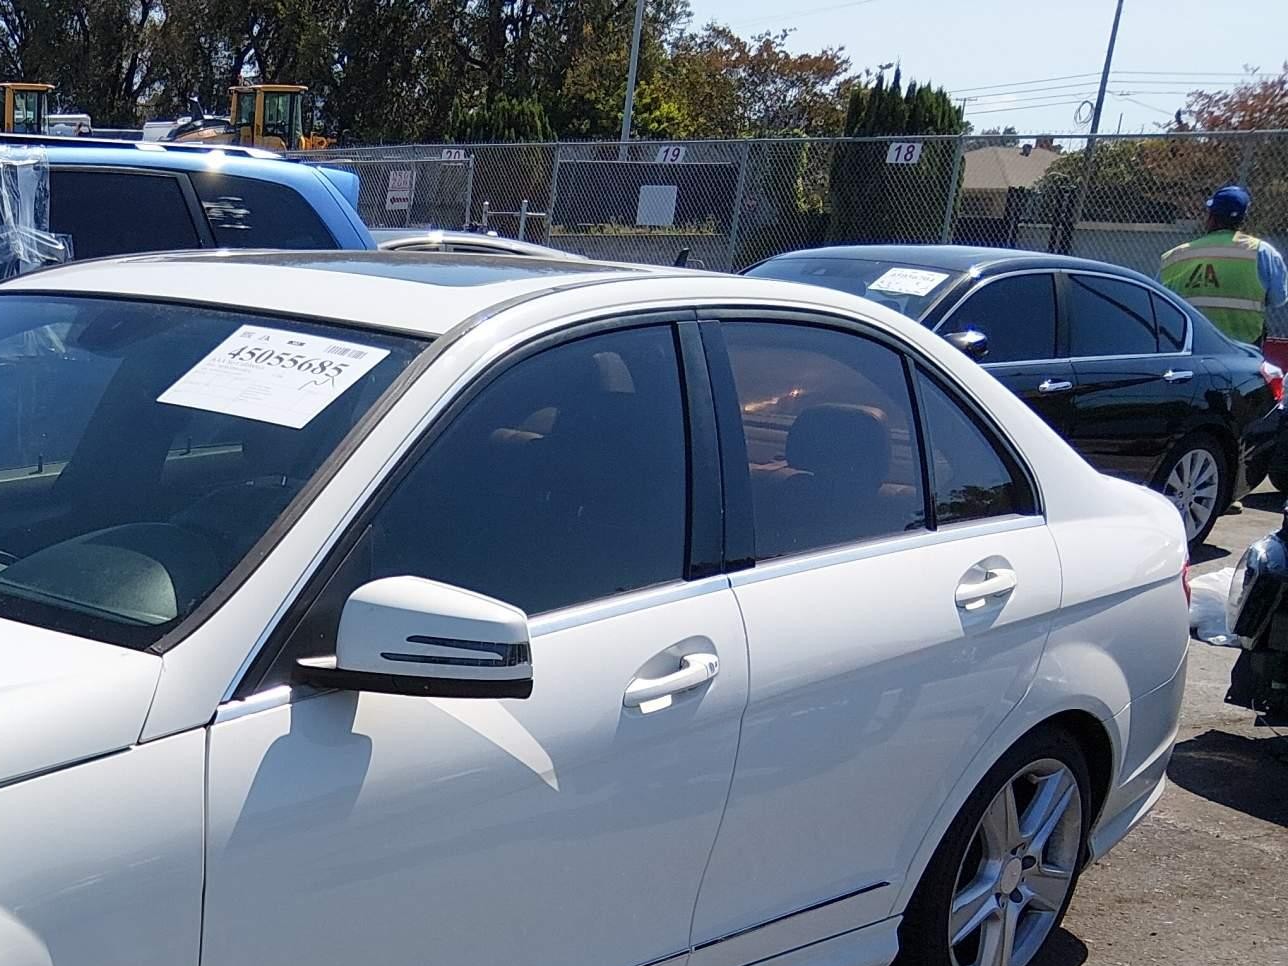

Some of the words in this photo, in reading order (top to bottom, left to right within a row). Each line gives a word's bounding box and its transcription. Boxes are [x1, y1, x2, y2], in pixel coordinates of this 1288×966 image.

[661, 147, 681, 162] 19
[895, 145, 914, 162] 18
[228, 346, 350, 377] 45055685
